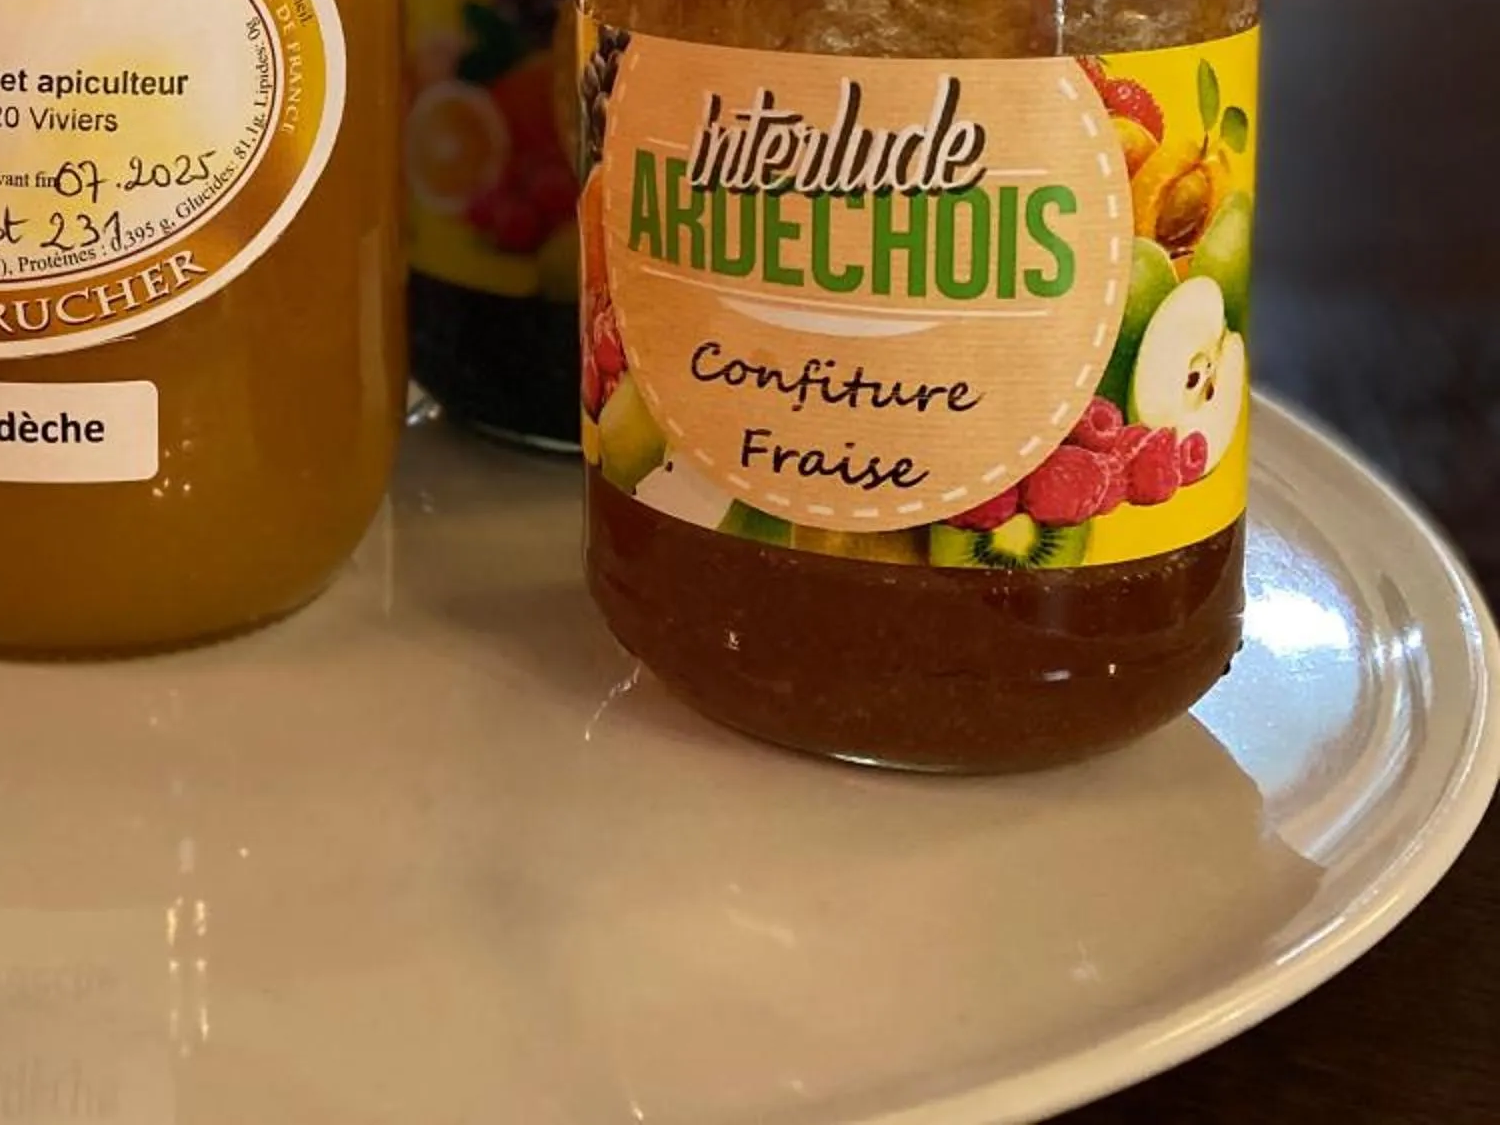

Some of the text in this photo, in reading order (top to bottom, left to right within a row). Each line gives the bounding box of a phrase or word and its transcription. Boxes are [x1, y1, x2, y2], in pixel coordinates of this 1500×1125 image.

[275, 3, 297, 36] DE
[37, 70, 189, 99] apiculteur
[283, 41, 303, 134] FRANCE
[29, 105, 119, 132] Viviers
[40, 210, 121, 251] 231
[18, 247, 97, 273] Protéines
[689, 340, 985, 413] Confiture
[740, 428, 931, 490] Fraise
